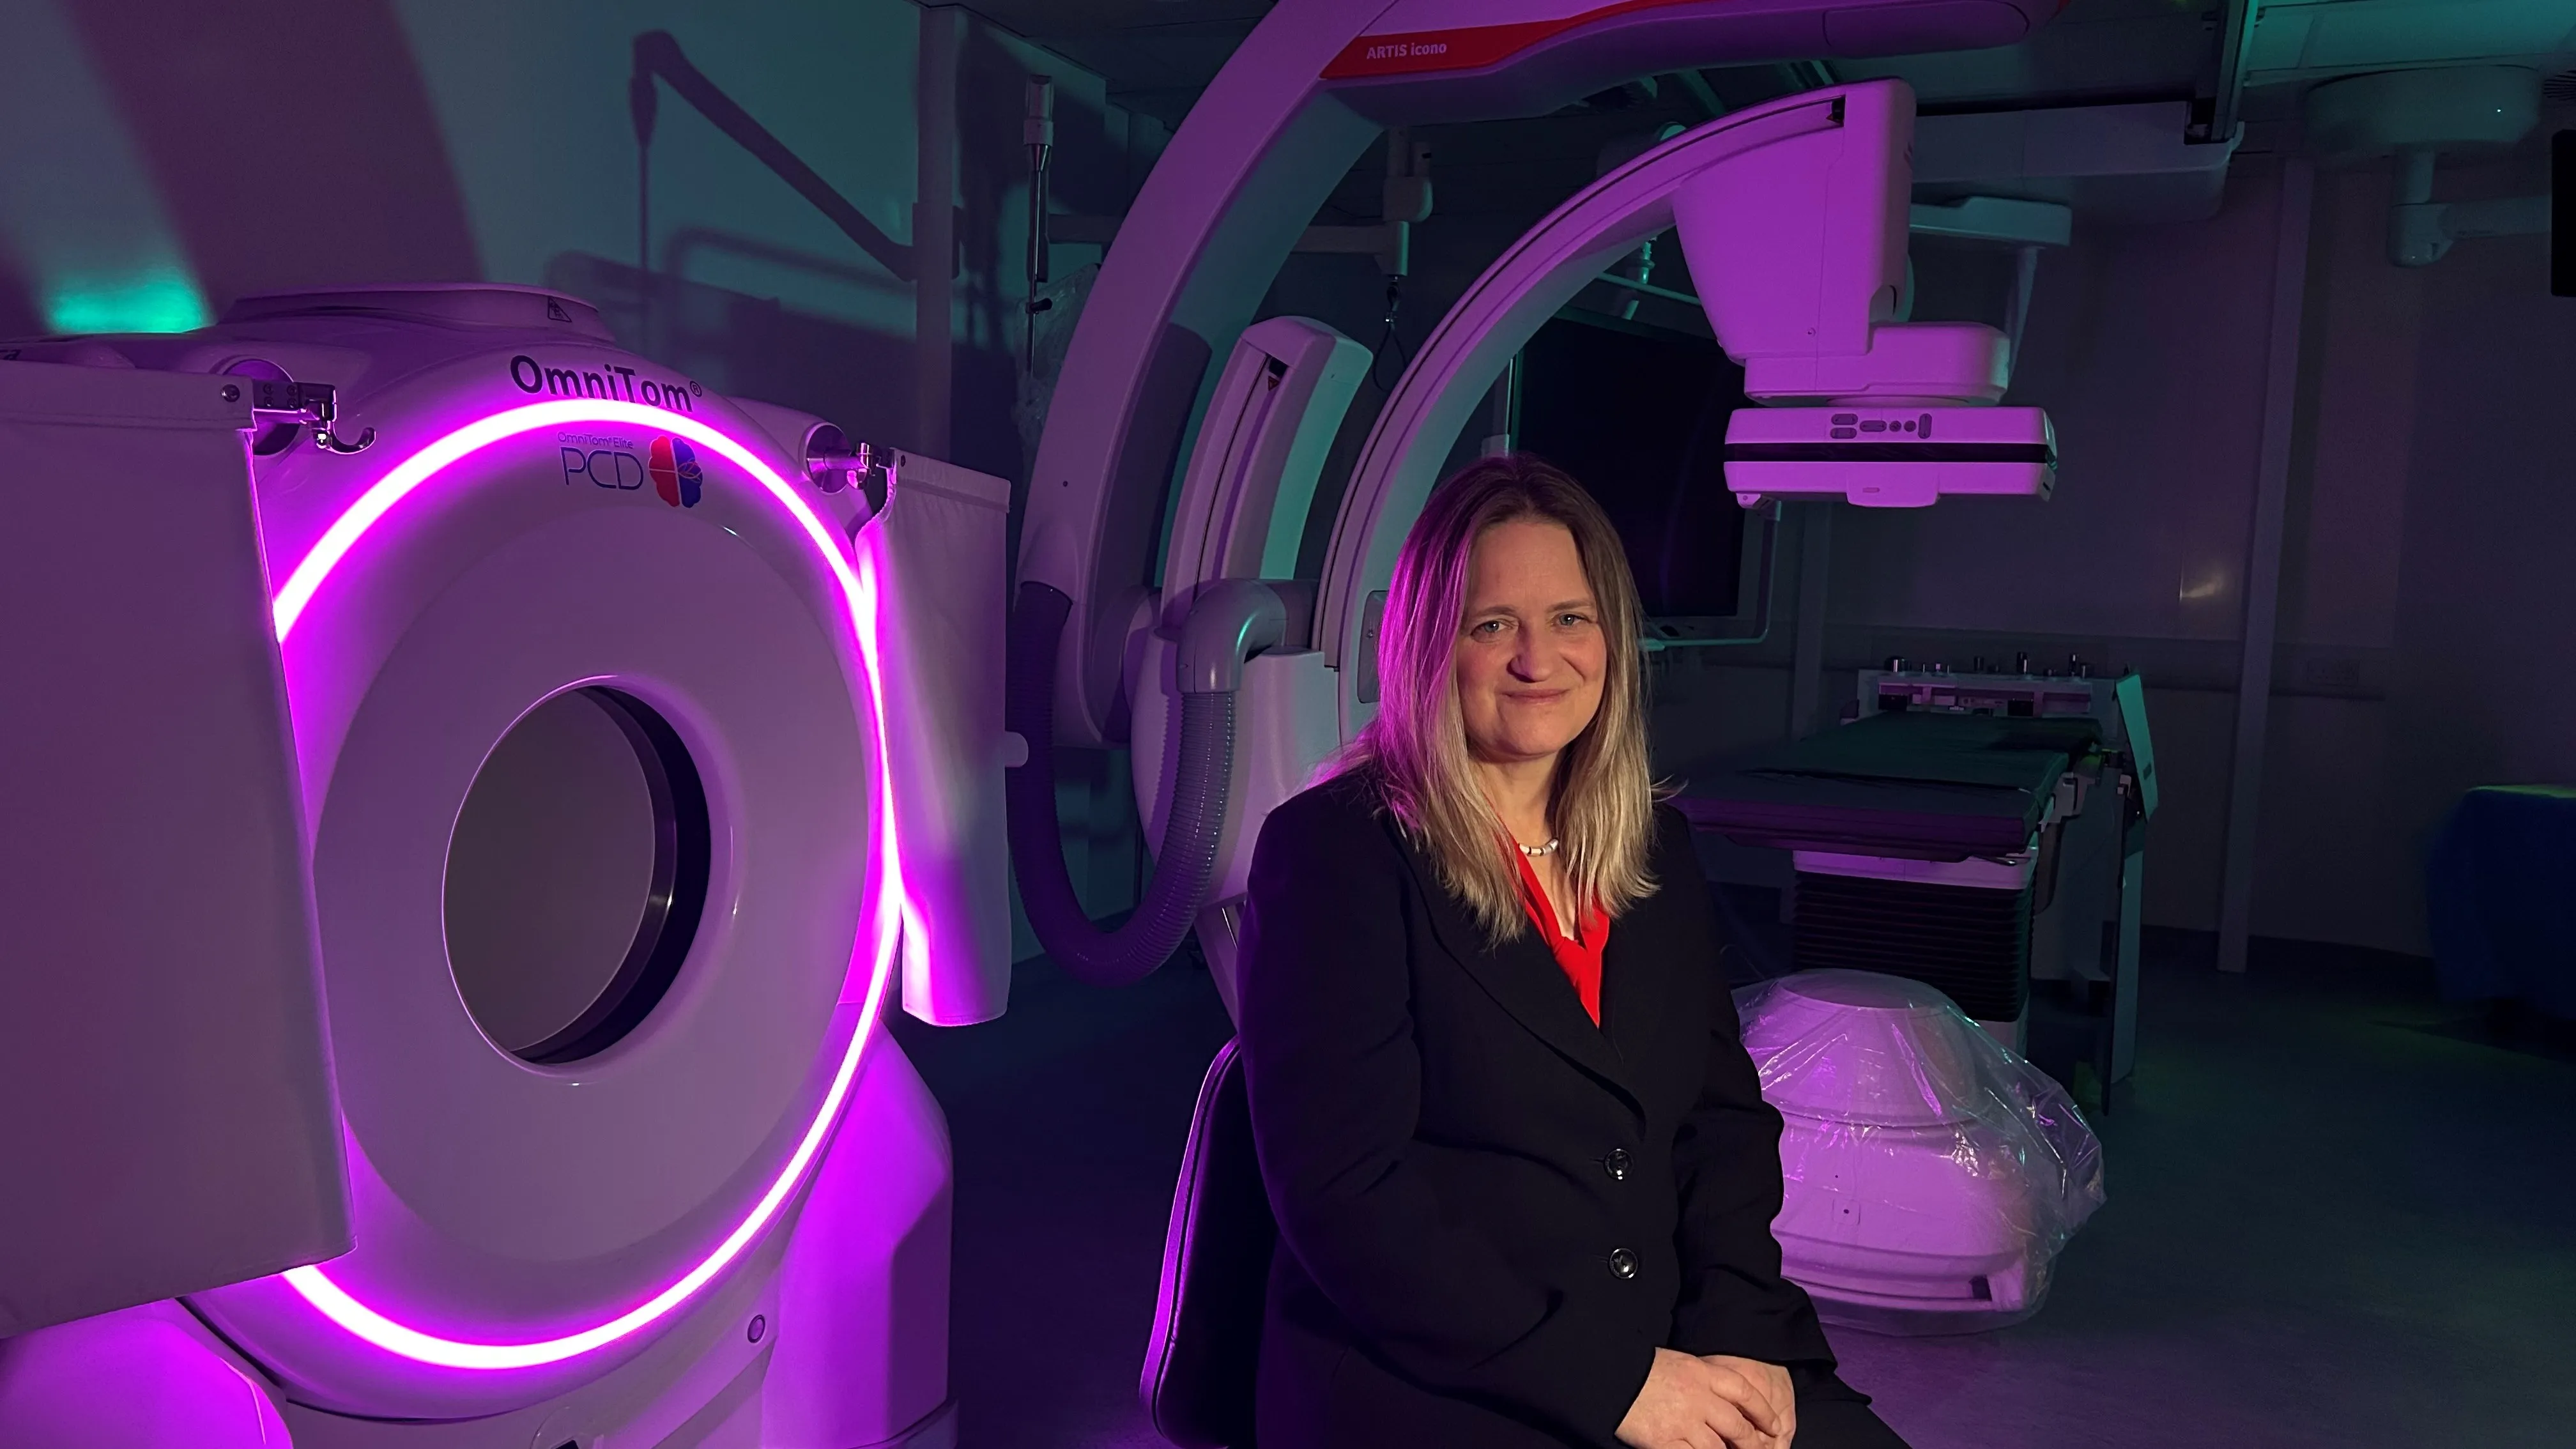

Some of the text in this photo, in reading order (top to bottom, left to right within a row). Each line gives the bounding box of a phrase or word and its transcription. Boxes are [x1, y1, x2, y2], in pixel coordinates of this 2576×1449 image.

[1366, 42, 1447, 59] ARTIS icono
[613, 437, 633, 449] Elite
[561, 447, 643, 490] PCD
